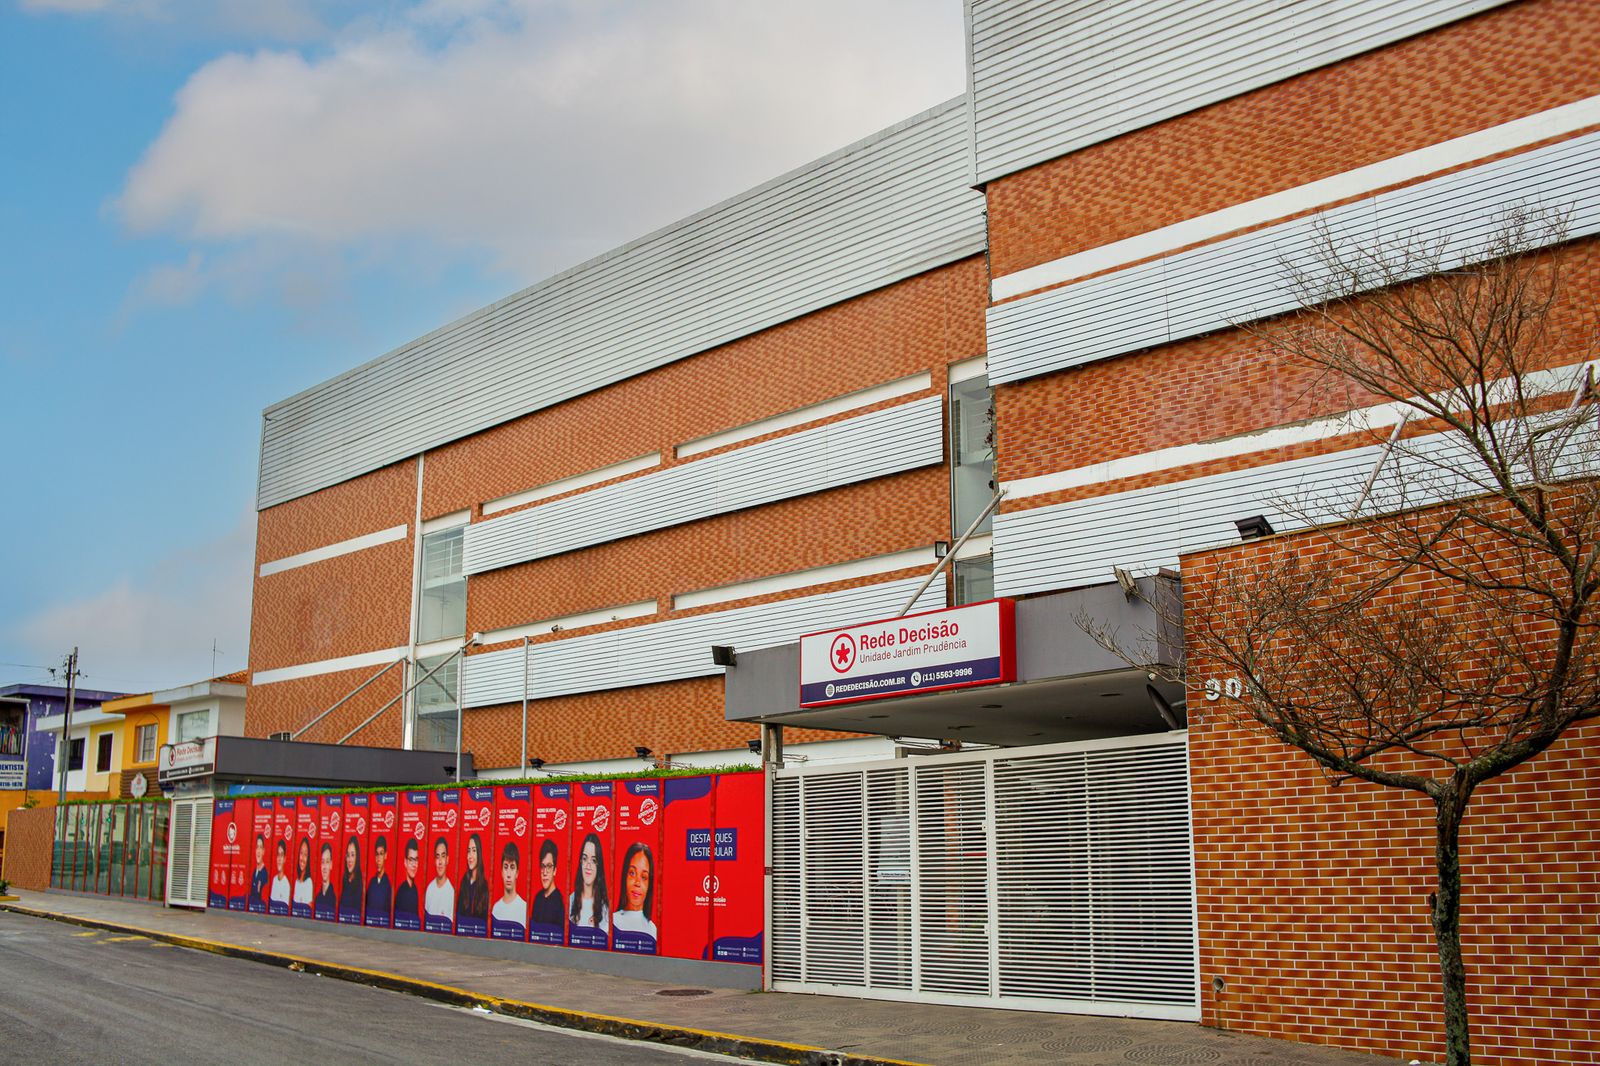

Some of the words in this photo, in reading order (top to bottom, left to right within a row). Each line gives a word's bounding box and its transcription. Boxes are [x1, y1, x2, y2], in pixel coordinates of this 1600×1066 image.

[860, 630, 895, 650] Rede
[899, 620, 959, 645] Decisão
[860, 650, 892, 664] Unidade
[893, 646, 921, 658] Jardim
[924, 639, 967, 654] Prudência
[922, 672, 936, 682] (11)
[936, 668, 972, 680] 5563-9996
[835, 677, 906, 693] REDEDECISÃO.COM.BR
[690, 833, 733, 844] DESTAQUES
